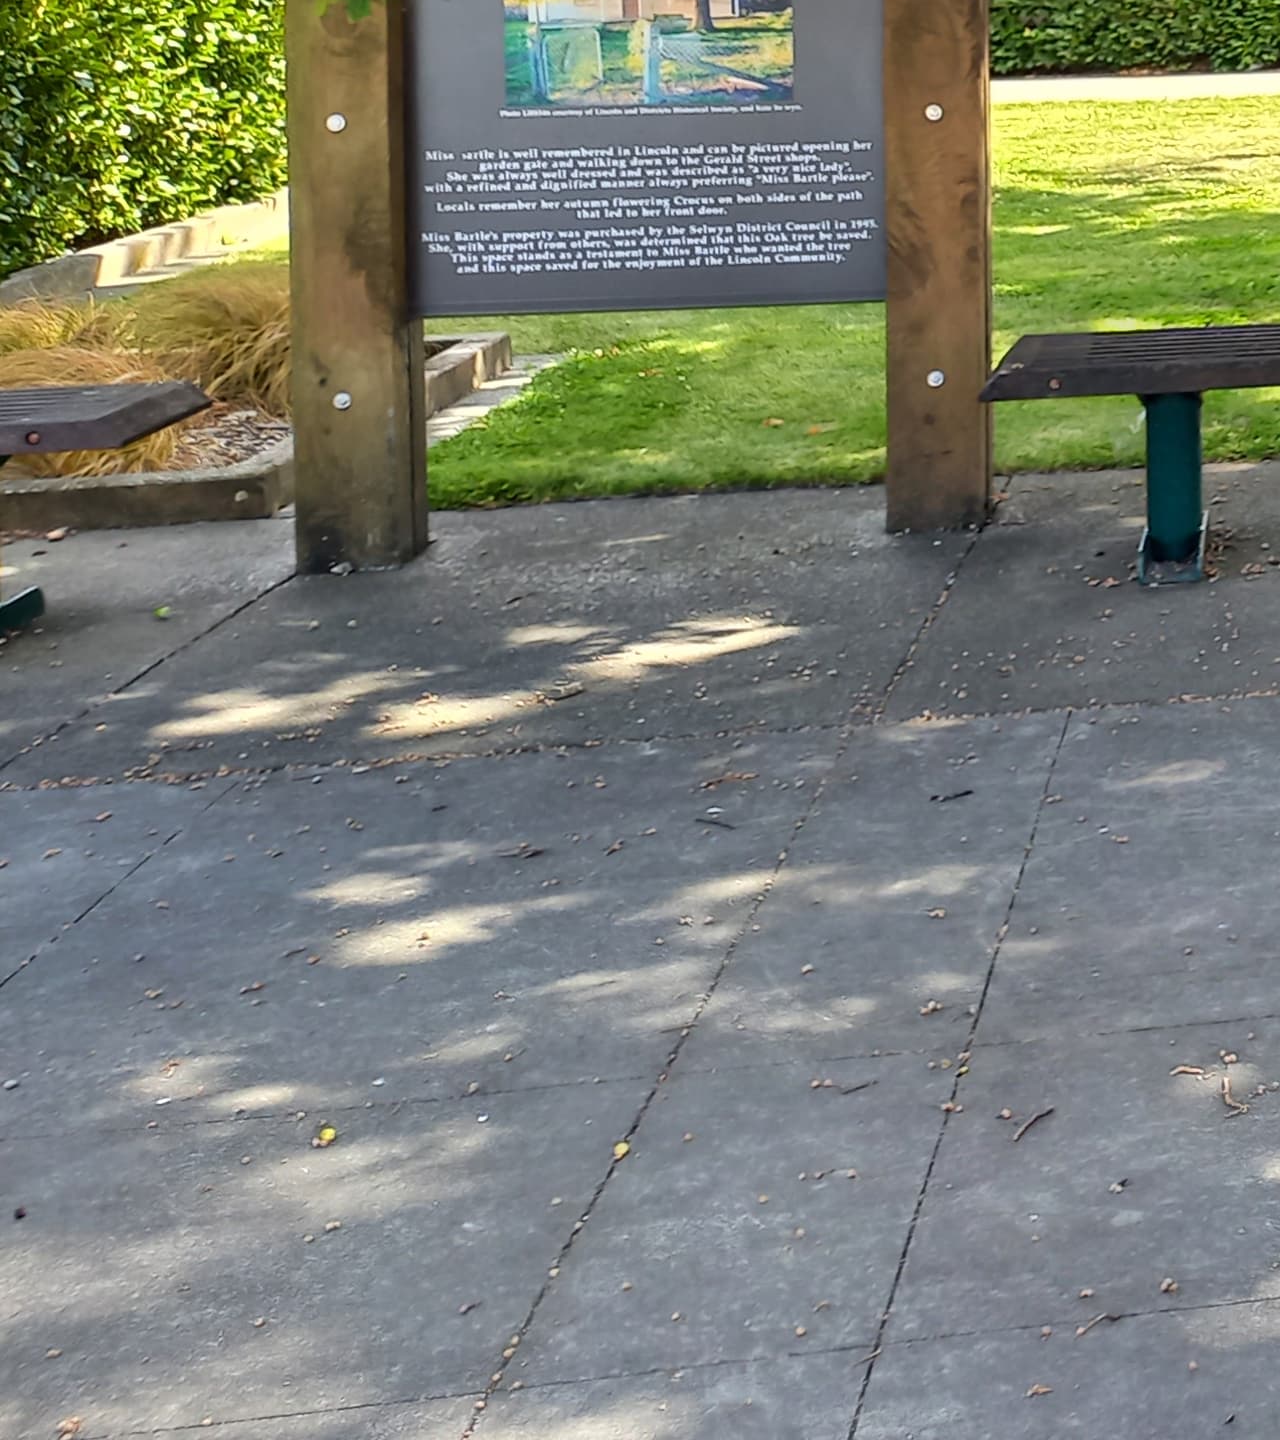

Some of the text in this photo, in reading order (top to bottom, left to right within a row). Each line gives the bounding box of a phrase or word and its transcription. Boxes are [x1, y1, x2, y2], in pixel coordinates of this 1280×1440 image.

[424, 140, 872, 160] Miss is well remembered in Lincoln and can be pictured opening her
[446, 171, 468, 182] She
[471, 172, 494, 181] was
[497, 169, 538, 182] always
[541, 169, 566, 179] well
[570, 167, 616, 178] dressed
[619, 167, 641, 177] and
[644, 168, 667, 177] was
[671, 165, 728, 176] described
[731, 166, 744, 174] as
[762, 165, 788, 176] very
[792, 162, 816, 173] nice
[478, 153, 822, 172] garden gate and walking down to the Gerald Street shops.
[424, 182, 452, 192] with
[455, 184, 462, 192] a
[466, 181, 510, 192] refined
[514, 180, 536, 190] and
[540, 179, 596, 192] dignified
[600, 180, 644, 188] manner
[648, 177, 688, 189] always
[691, 175, 752, 188] preferring
[793, 173, 828, 184] Bartle
[436, 190, 864, 212] Locals remember her autumn flowering Crocus on both sides of the path
[576, 205, 728, 219] that led to her front door.
[420, 220, 846, 242] Miss Bartle's property was purchased by the Selwyn District Council in
[428, 230, 872, 255] She, with support from others, was determined that this Oak tree be saved.
[450, 242, 852, 264] This space stands as a testament to Miss Bartle who wanted the tree
[456, 252, 846, 274] and this space saved for the enjoyment of the Lincoln Community.
